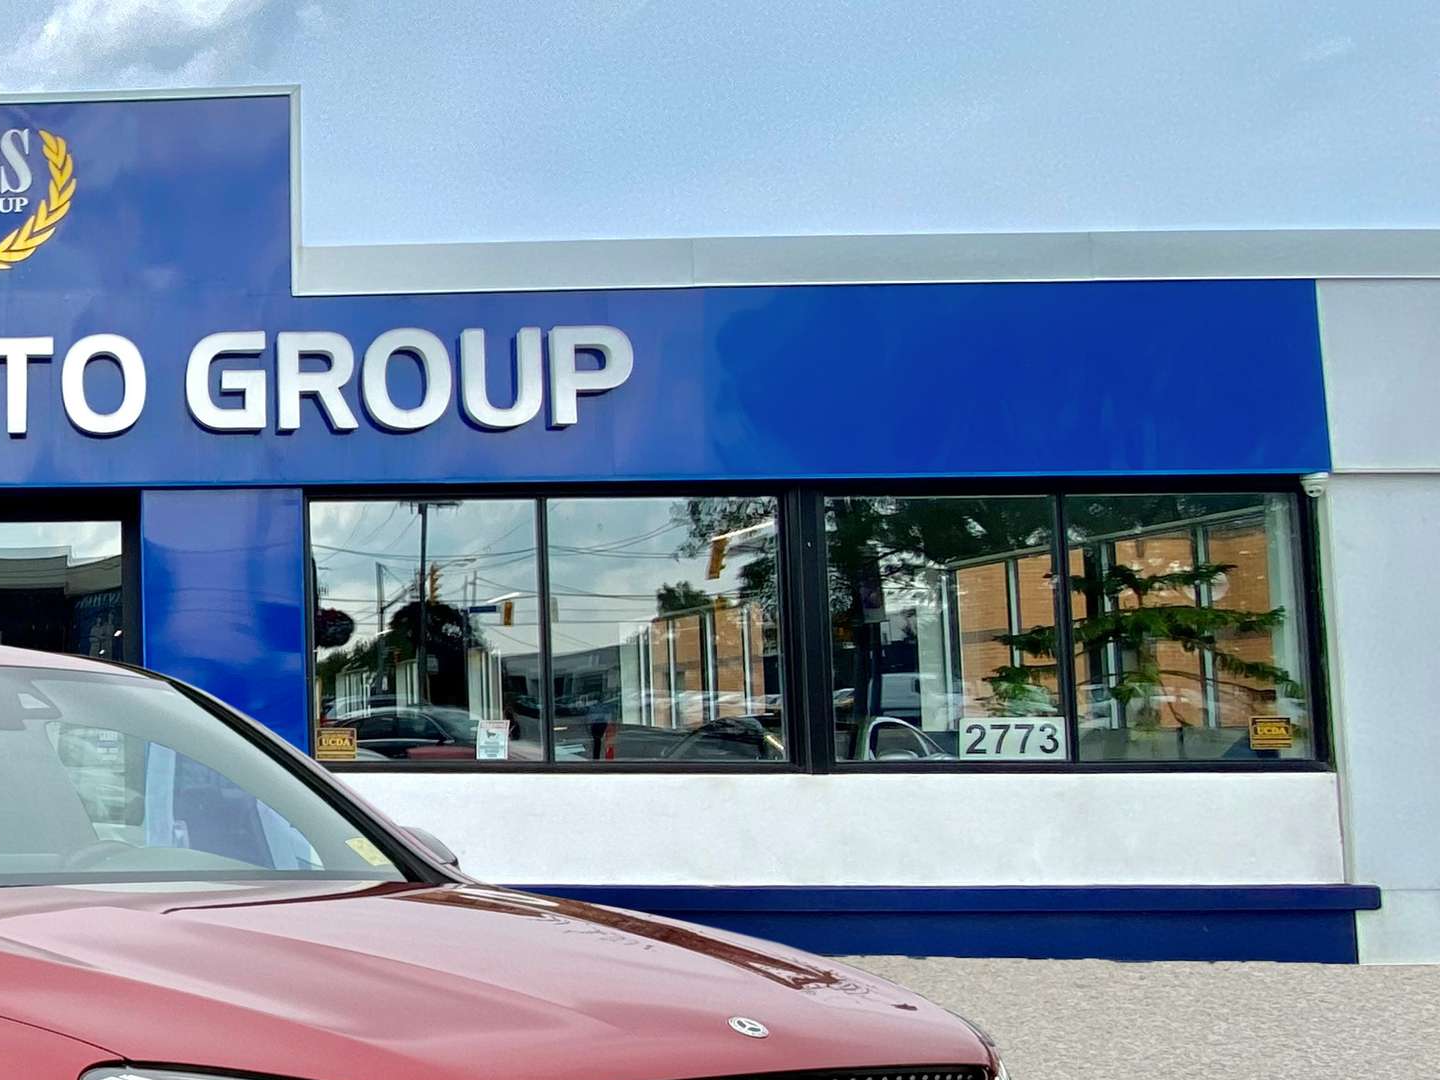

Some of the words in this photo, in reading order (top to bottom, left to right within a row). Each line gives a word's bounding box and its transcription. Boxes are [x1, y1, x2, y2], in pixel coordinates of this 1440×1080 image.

[185, 325, 635, 431] GROUP
[965, 723, 1060, 754] 2773
[1256, 726, 1288, 735] UCDA
[322, 737, 351, 746] UCDA
